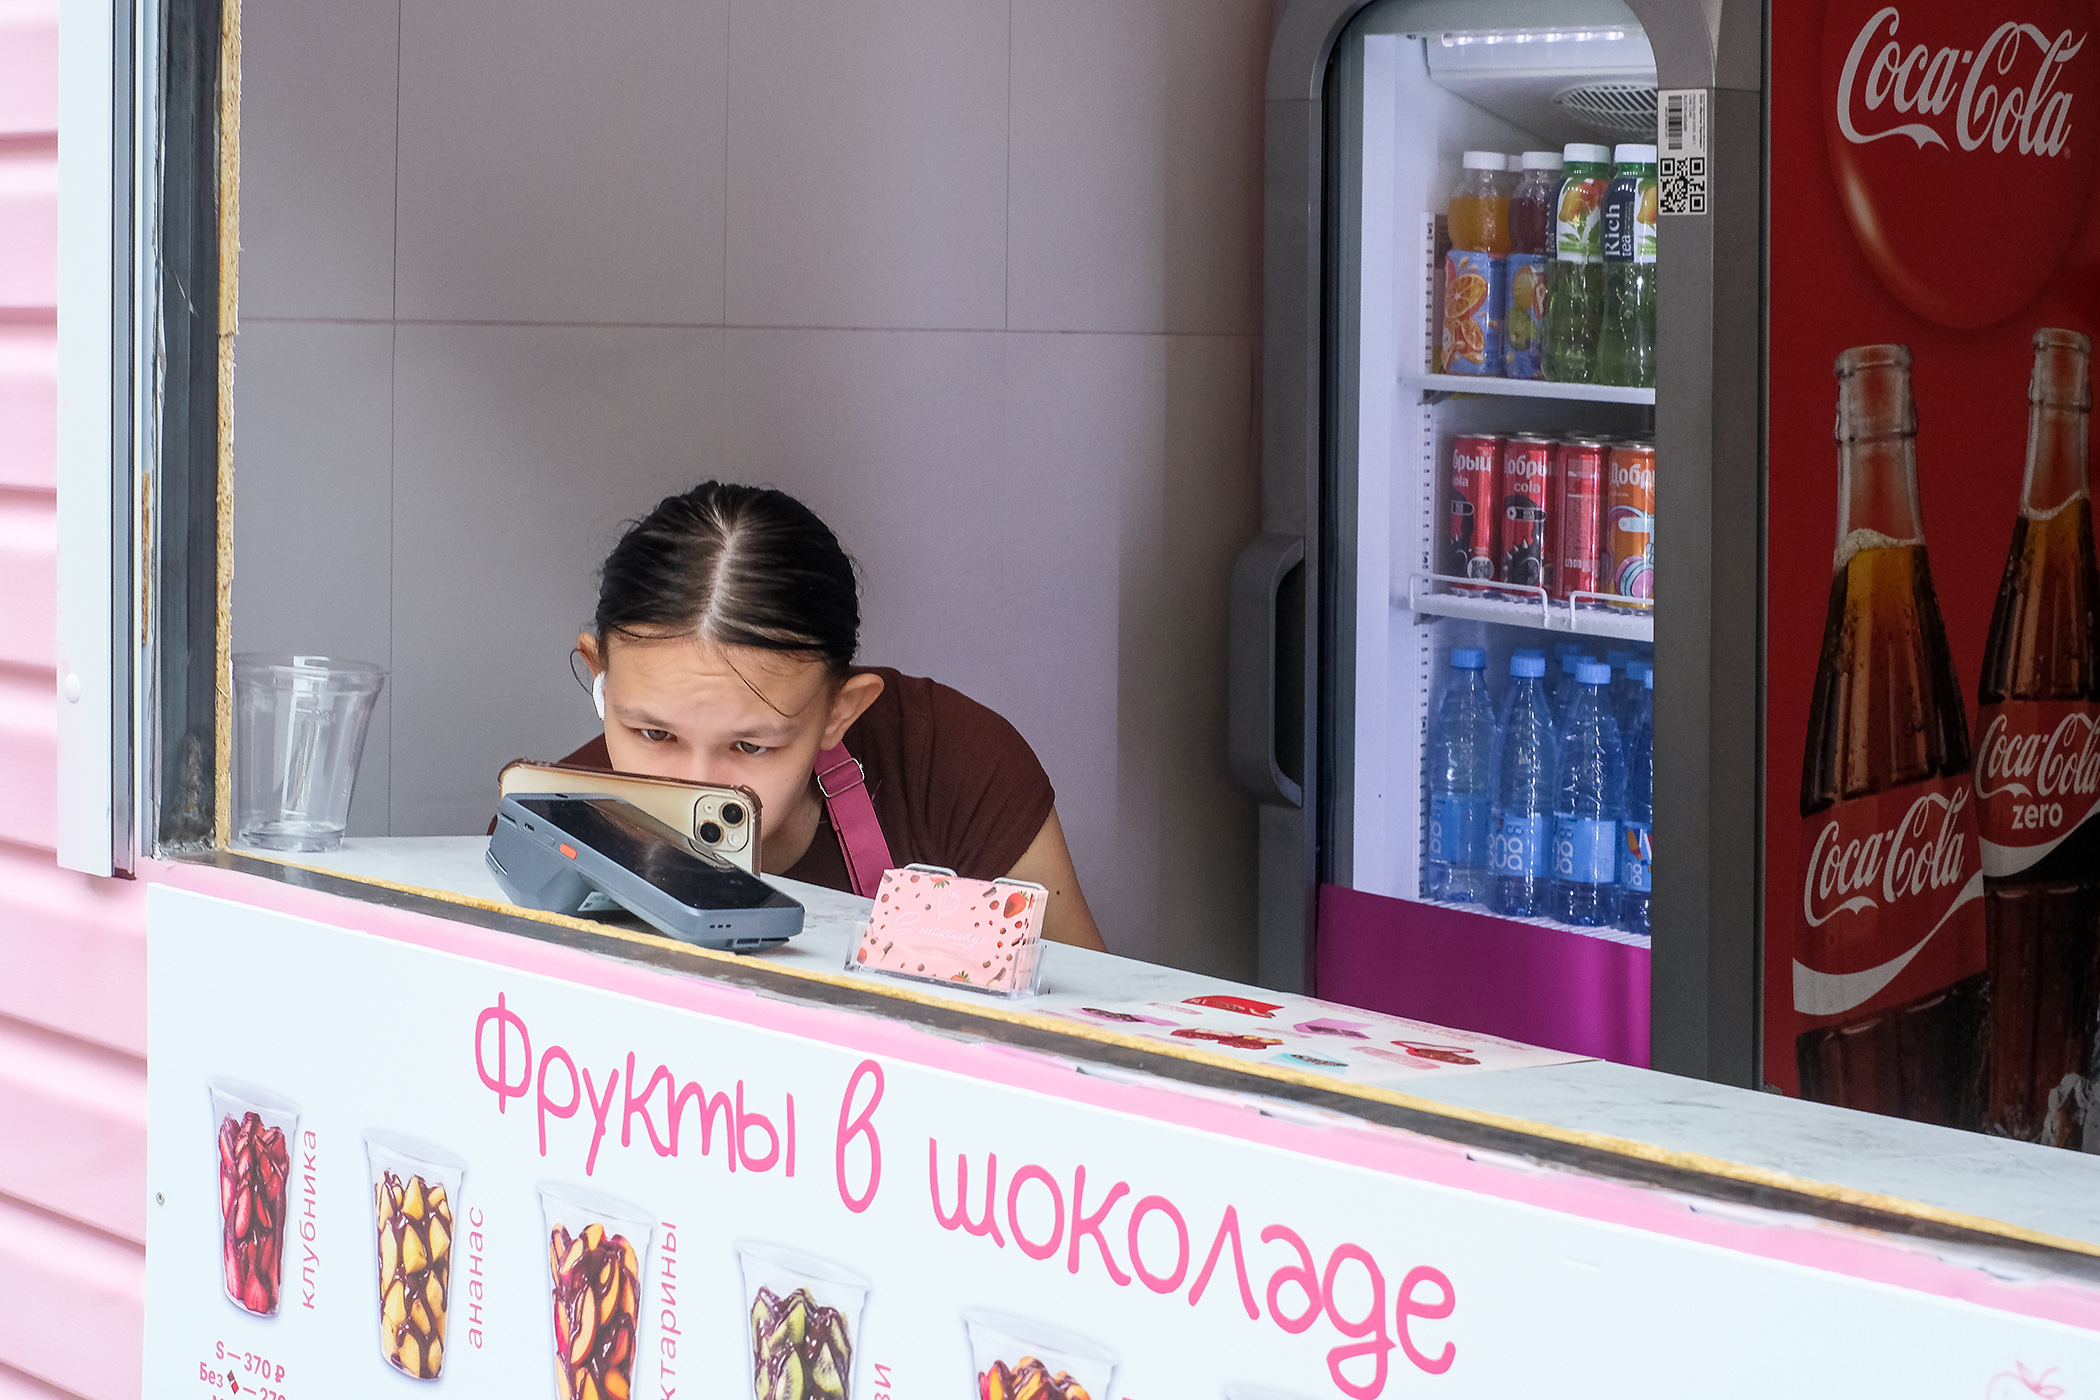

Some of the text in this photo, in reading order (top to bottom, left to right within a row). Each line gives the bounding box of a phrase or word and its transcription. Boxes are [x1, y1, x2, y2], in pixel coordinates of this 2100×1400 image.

[1837, 6, 2088, 158] Coca-Cola
[1604, 204, 1620, 256] Rich
[1621, 234, 1632, 257] tea
[1513, 480, 1542, 494] cola
[1804, 786, 1971, 928] Coca-Cola
[2011, 801, 2063, 830] zero
[300, 1130, 320, 1310] клубника
[474, 992, 1457, 1400] Фрукты в шоколаде
[468, 1206, 486, 1350] ананас
[199, 1361, 224, 1389] Без
